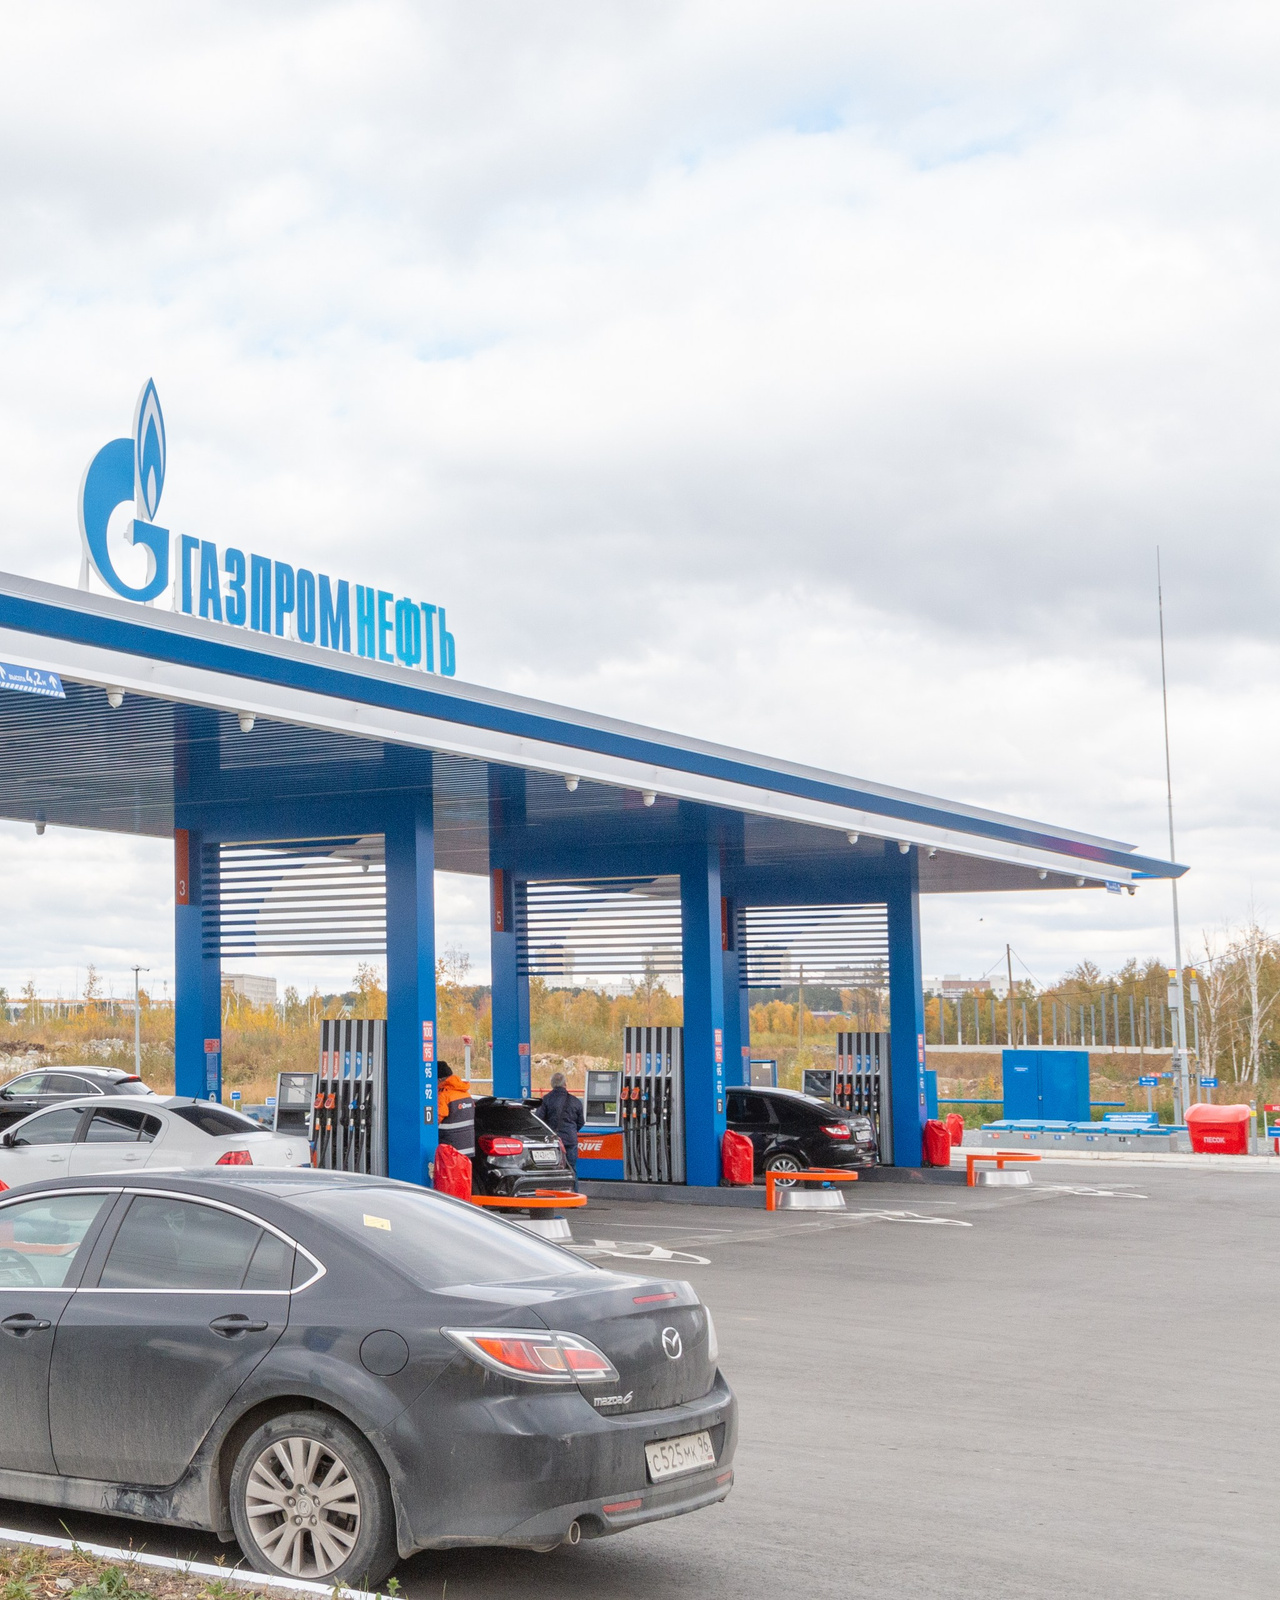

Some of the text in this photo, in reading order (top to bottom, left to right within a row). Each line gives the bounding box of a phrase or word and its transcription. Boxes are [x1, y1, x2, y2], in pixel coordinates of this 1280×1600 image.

[179, 880, 186, 896] 3
[496, 910, 502, 925] 5
[423, 1027, 433, 1037] 100
[424, 1048, 432, 1058] 95
[424, 1068, 432, 1078] 95
[424, 1089, 433, 1099] 92
[426, 1111, 432, 1122] D
[1203, 1136, 1226, 1144] ПЕСОК
[577, 1142, 602, 1152] RIVE
